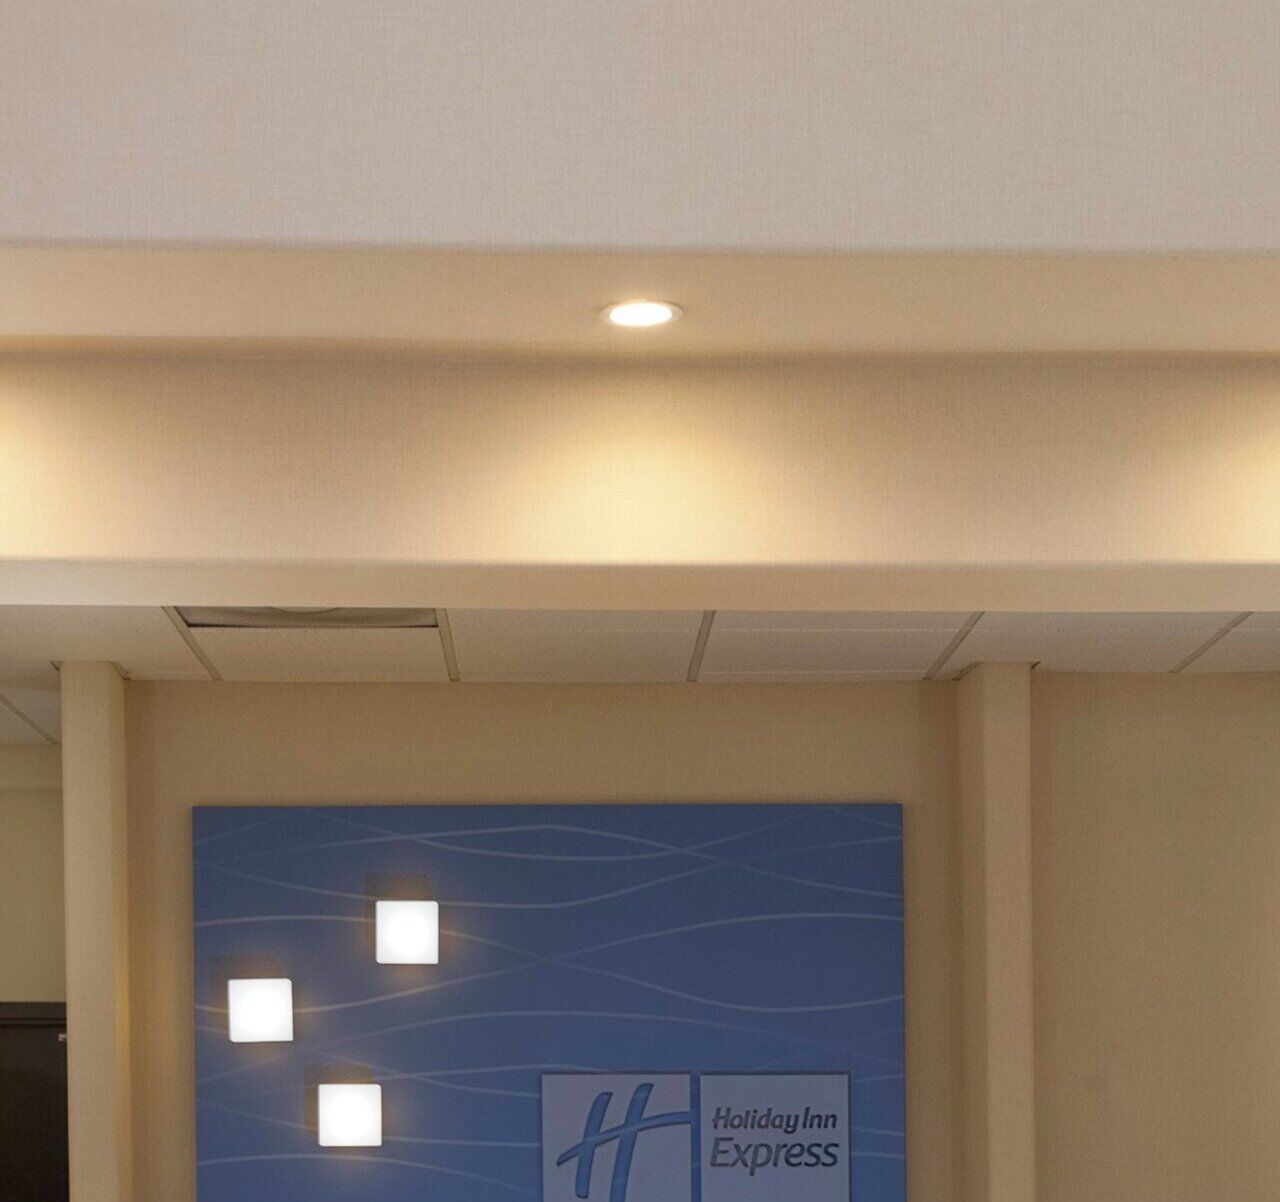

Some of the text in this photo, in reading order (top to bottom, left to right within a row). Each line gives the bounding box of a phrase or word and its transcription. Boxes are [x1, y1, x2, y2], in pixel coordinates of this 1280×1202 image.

[712, 1107, 837, 1134] Holiday Inn
[709, 1137, 839, 1176] Express
